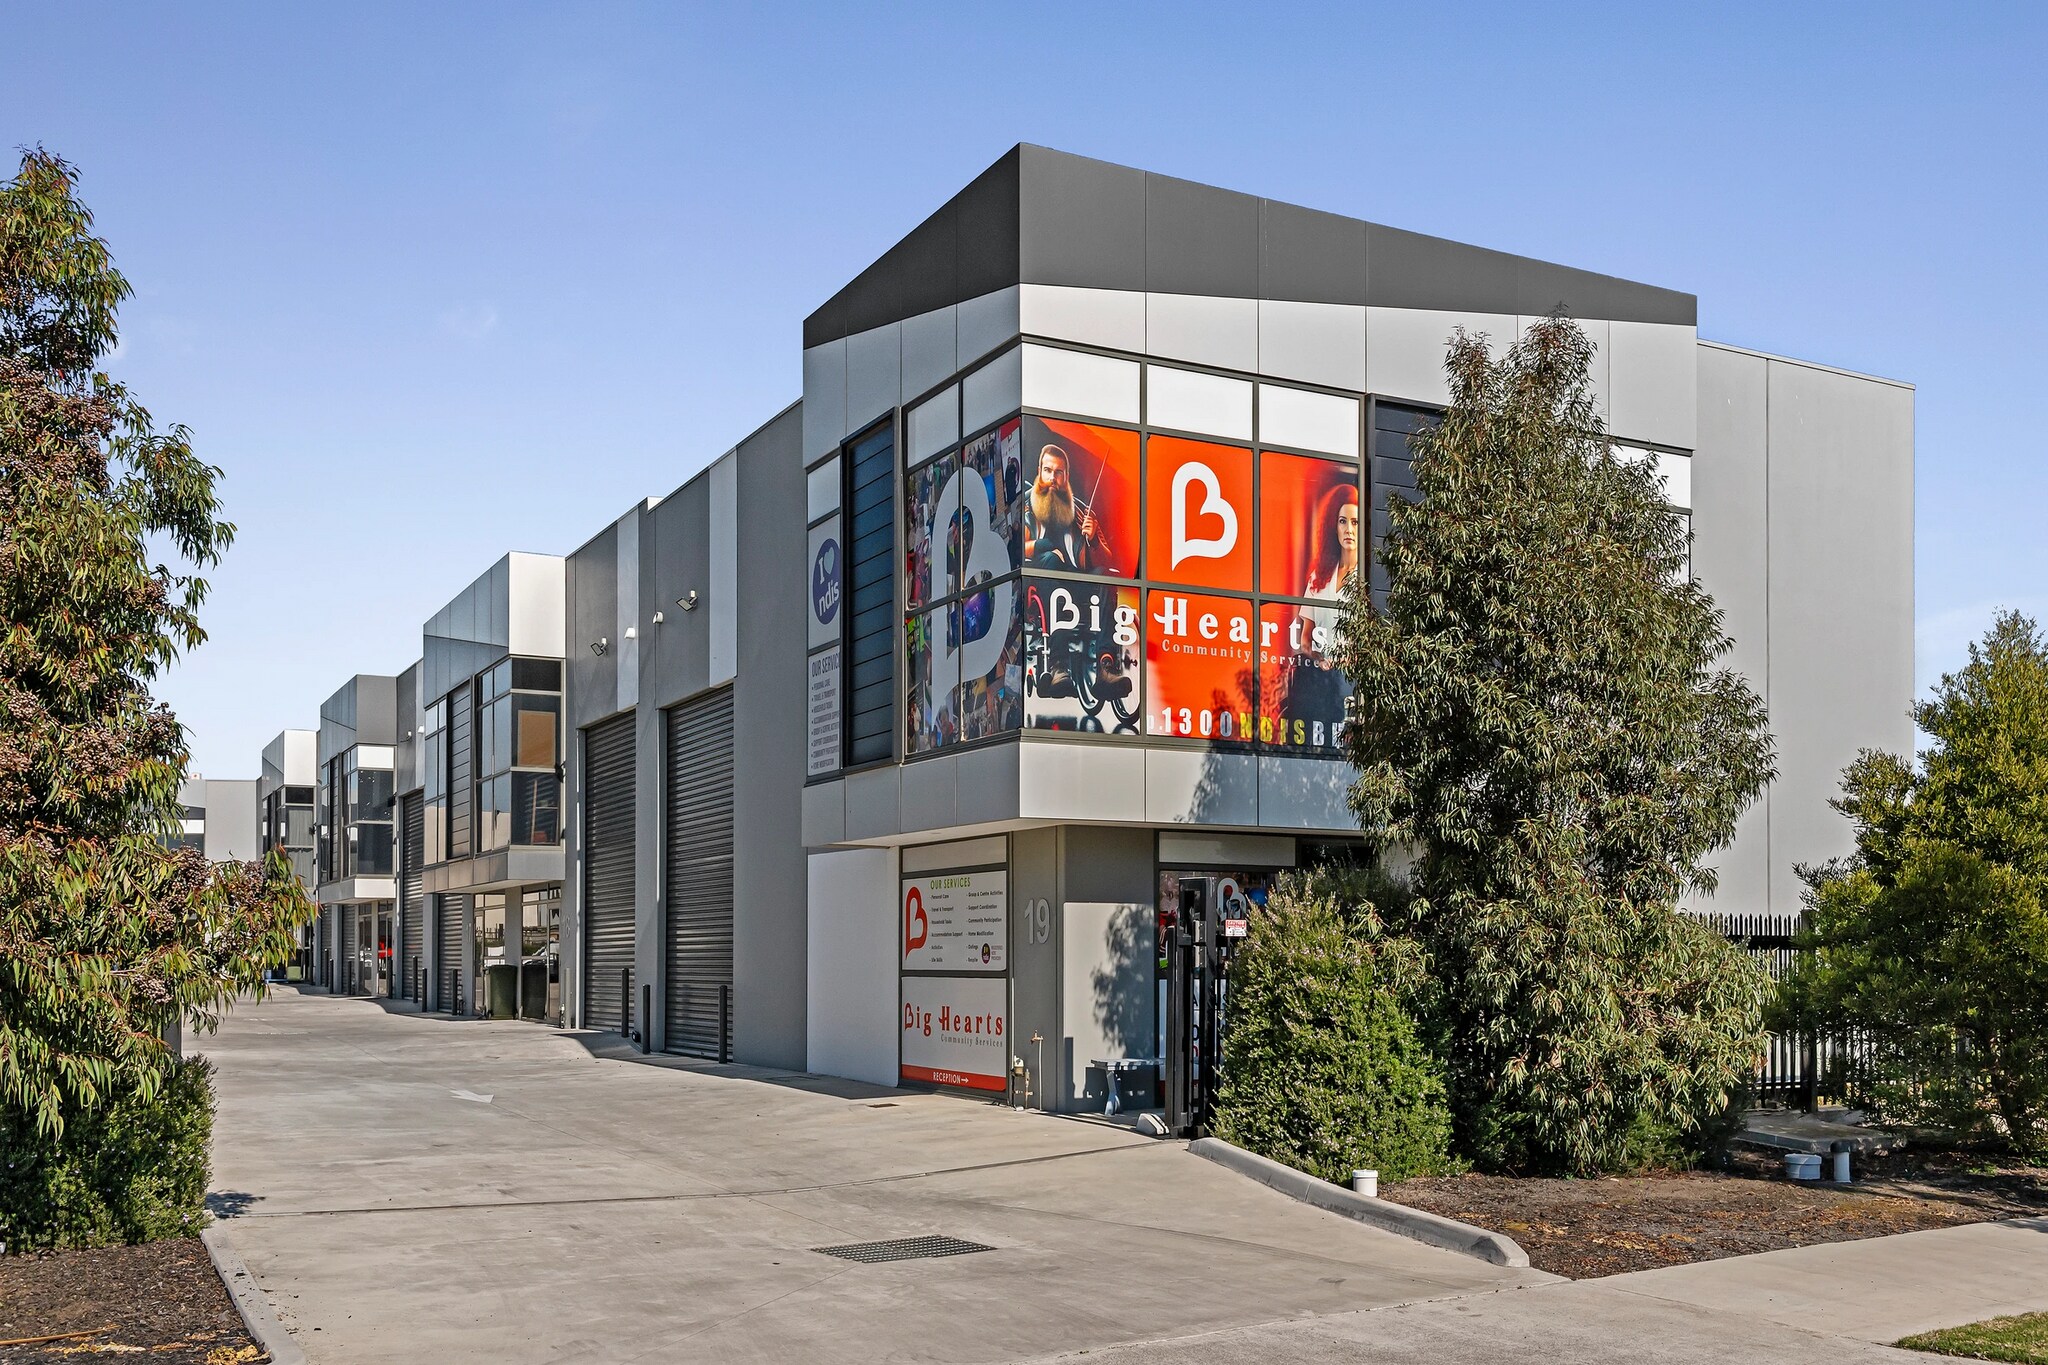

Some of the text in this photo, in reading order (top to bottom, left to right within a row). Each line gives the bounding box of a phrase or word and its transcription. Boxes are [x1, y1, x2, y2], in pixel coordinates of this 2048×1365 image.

[819, 580, 840, 616] ndis
[1050, 588, 1329, 653] Big Hearts
[1162, 639, 1251, 662] Community
[930, 877, 971, 890] OUR SERVICES
[1024, 899, 1050, 944] 19
[905, 1002, 1003, 1037] Big Hearts
[941, 1034, 1003, 1048] Community Services
[933, 1071, 961, 1084] RECEPTION
